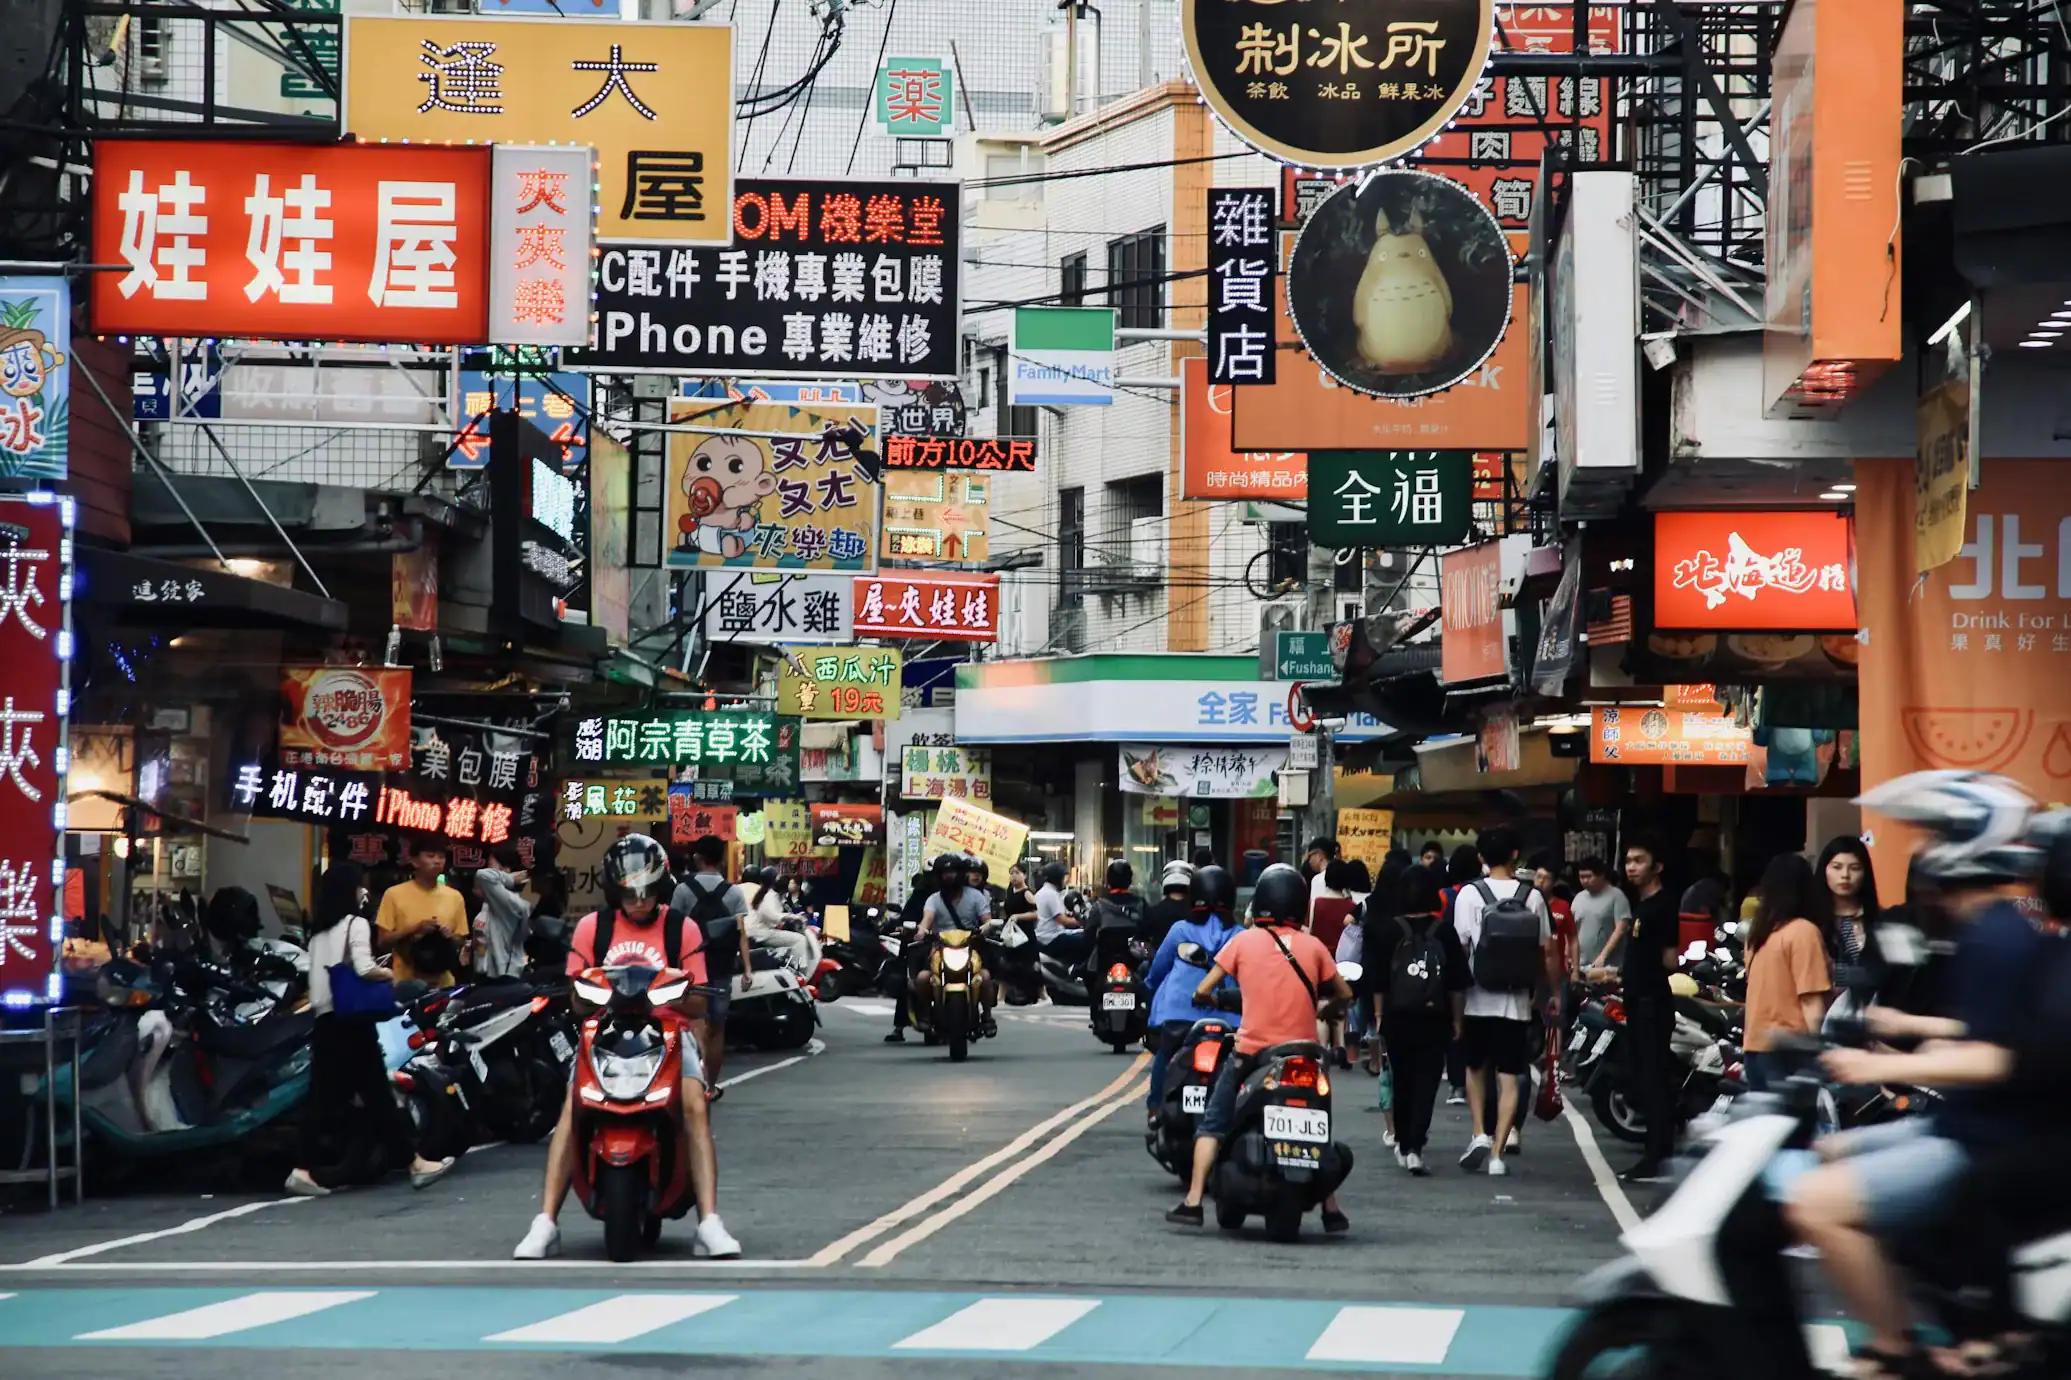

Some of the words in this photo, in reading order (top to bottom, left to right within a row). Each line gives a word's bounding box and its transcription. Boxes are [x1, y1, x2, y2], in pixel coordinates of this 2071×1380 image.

[1235, 20, 1446, 77] 制冰所
[1245, 82, 1290, 101] 茶飲
[1317, 82, 1361, 101] 冰品
[1378, 82, 1446, 102] 鮮果冰
[620, 150, 706, 221] 屋
[117, 168, 459, 310] 娃娃屋
[820, 195, 945, 245] 機樂堂
[716, 249, 944, 305] 手機專業包膜
[1213, 194, 1269, 380] 雜貨店
[781, 312, 932, 364] 專業維修
[1016, 362, 1110, 384] FamilyMart
[886, 435, 1036, 472] 前方10公尺
[1949, 513, 2071, 600] 北
[718, 589, 840, 634] 鹽水雞
[1952, 610, 2010, 630] Drink
[2019, 612, 2054, 630] For
[814, 654, 897, 687] 西瓜汁
[830, 685, 884, 714] 19元
[1199, 692, 1258, 726] 全家
[409, 736, 520, 790] 業包膜
[606, 718, 772, 763] 阿宗青草茶
[901, 776, 991, 799] 上海湯包
[376, 784, 442, 833] iPhone
[445, 796, 513, 845] 維修
